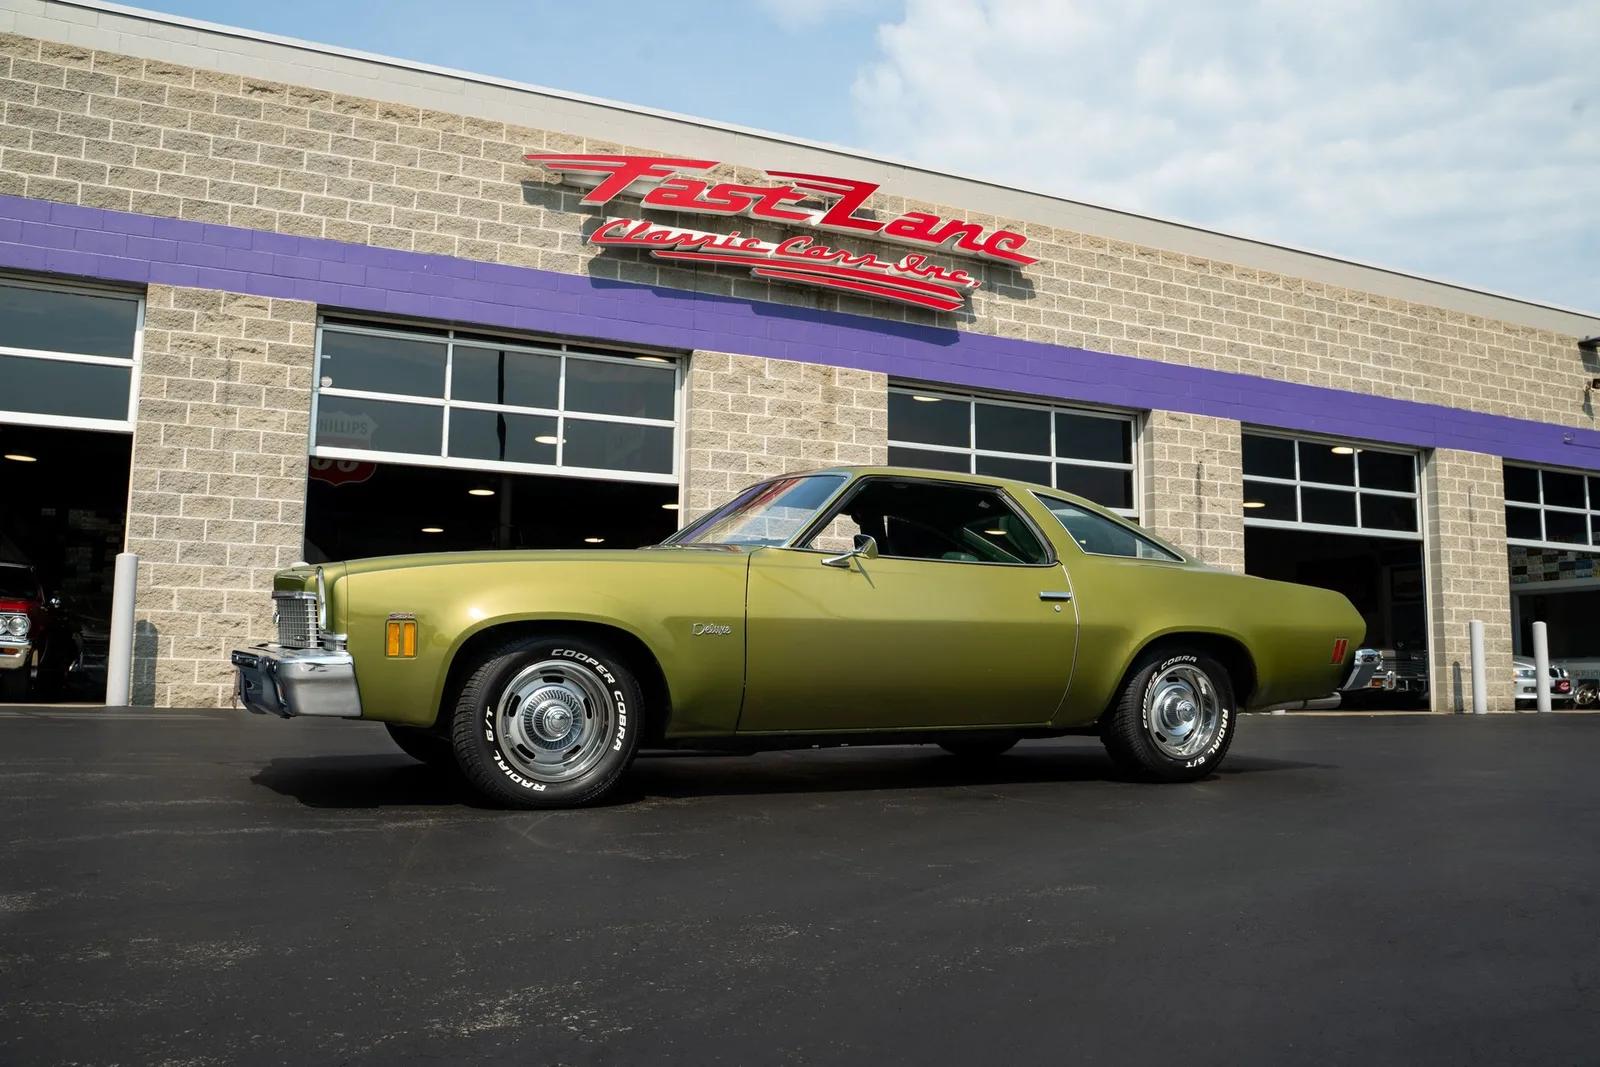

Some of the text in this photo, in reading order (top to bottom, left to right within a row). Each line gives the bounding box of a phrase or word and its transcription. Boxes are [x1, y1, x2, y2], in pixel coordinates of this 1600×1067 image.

[523, 153, 1039, 265] Fast Lane
[590, 218, 983, 289] Classic Cars Inc.
[318, 416, 368, 435] HILLIPS
[692, 622, 732, 636] Deluxe
[1160, 655, 1198, 671] COBRA
[551, 648, 628, 752] COOPER COBRA
[485, 705, 547, 792] RADIAL G/T
[1185, 708, 1230, 768] RADIAL G/T
